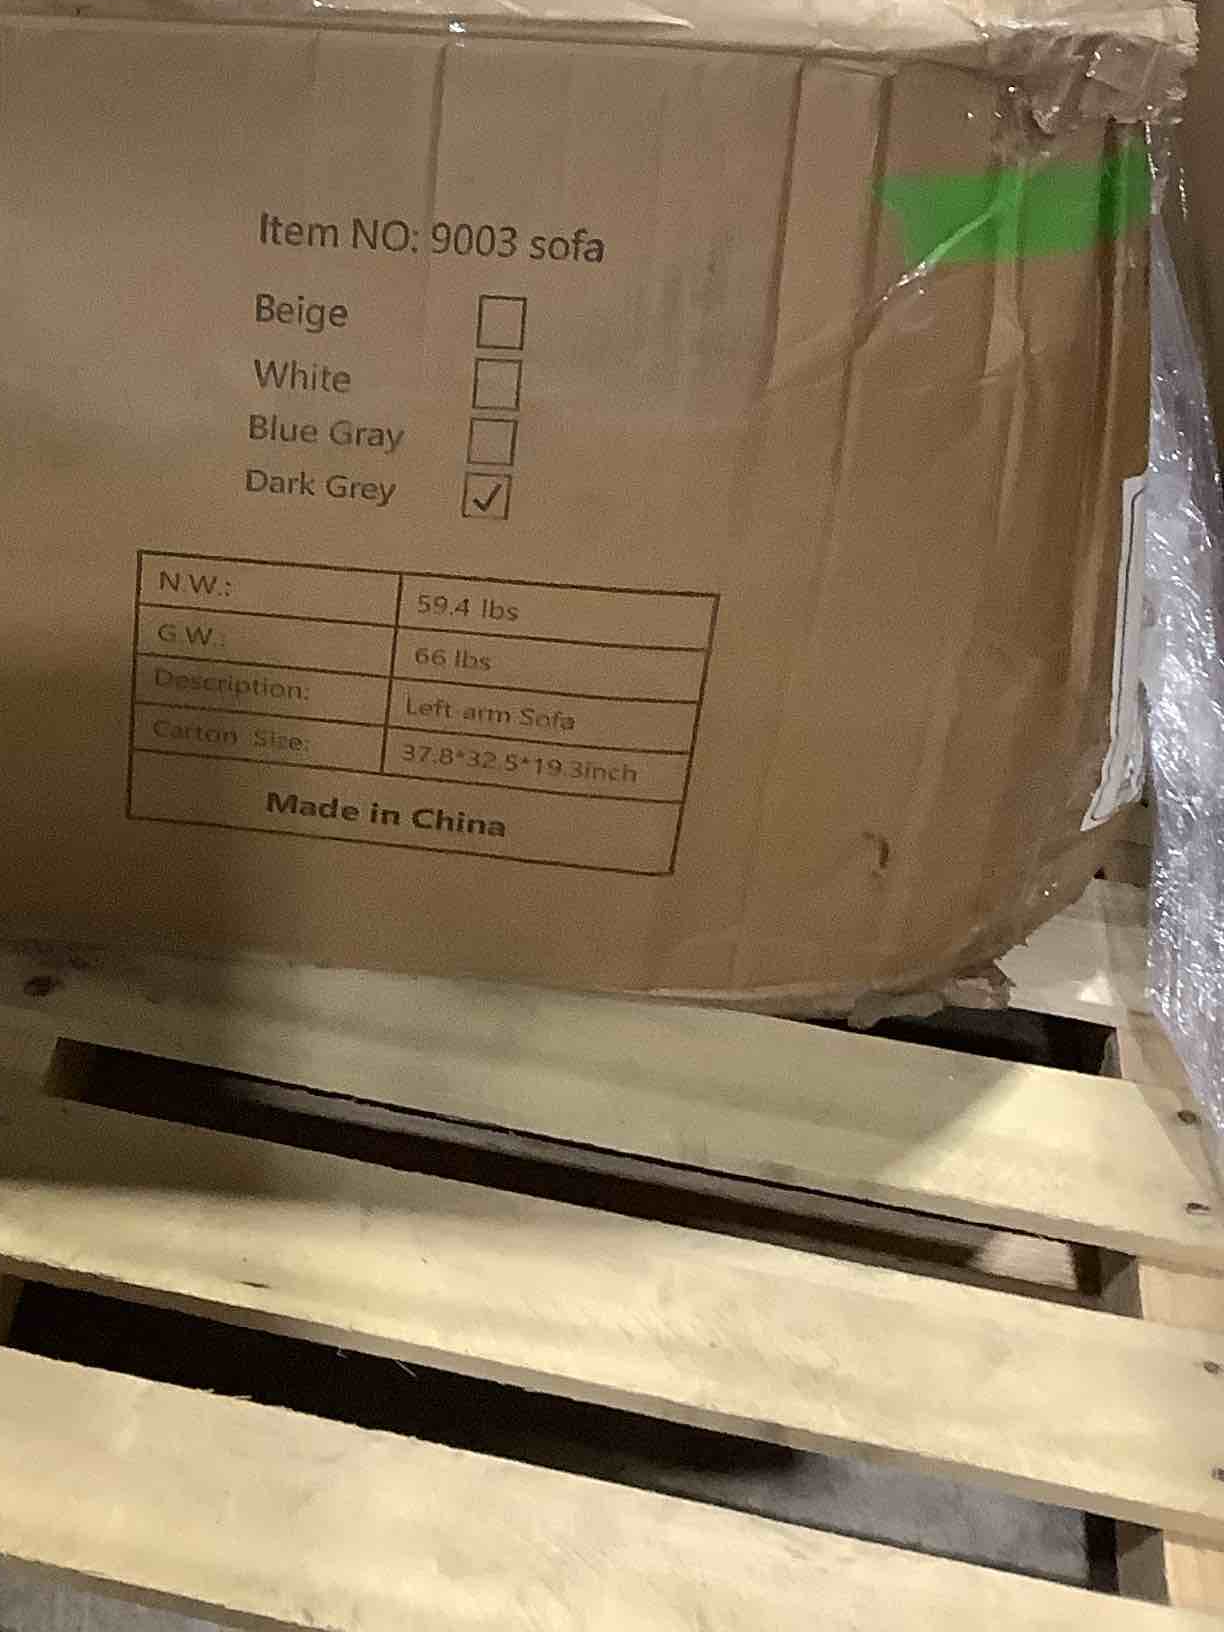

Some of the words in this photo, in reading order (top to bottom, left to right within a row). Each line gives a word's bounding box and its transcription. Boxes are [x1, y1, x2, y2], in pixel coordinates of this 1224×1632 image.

[260, 211, 339, 251] Item
[350, 218, 421, 254] NO:
[430, 222, 519, 258] 9003
[529, 227, 606, 263] sofa
[255, 292, 349, 333] Beige
[254, 358, 353, 394] White
[248, 413, 319, 446] Blue
[328, 420, 405, 455] Gray
[245, 469, 316, 498] Dark
[325, 474, 397, 508] Grey
[417, 594, 470, 617] 59.4
[481, 598, 521, 622] lbs
[415, 647, 447, 666] 66
[454, 648, 492, 671] lbs
[155, 668, 311, 704] Description:
[406, 696, 452, 718] Left
[462, 704, 511, 723] arm
[519, 707, 576, 731] Sofa
[152, 719, 239, 746] Carton
[266, 789, 361, 824] Made
[370, 801, 401, 827] in
[412, 806, 508, 839] China
